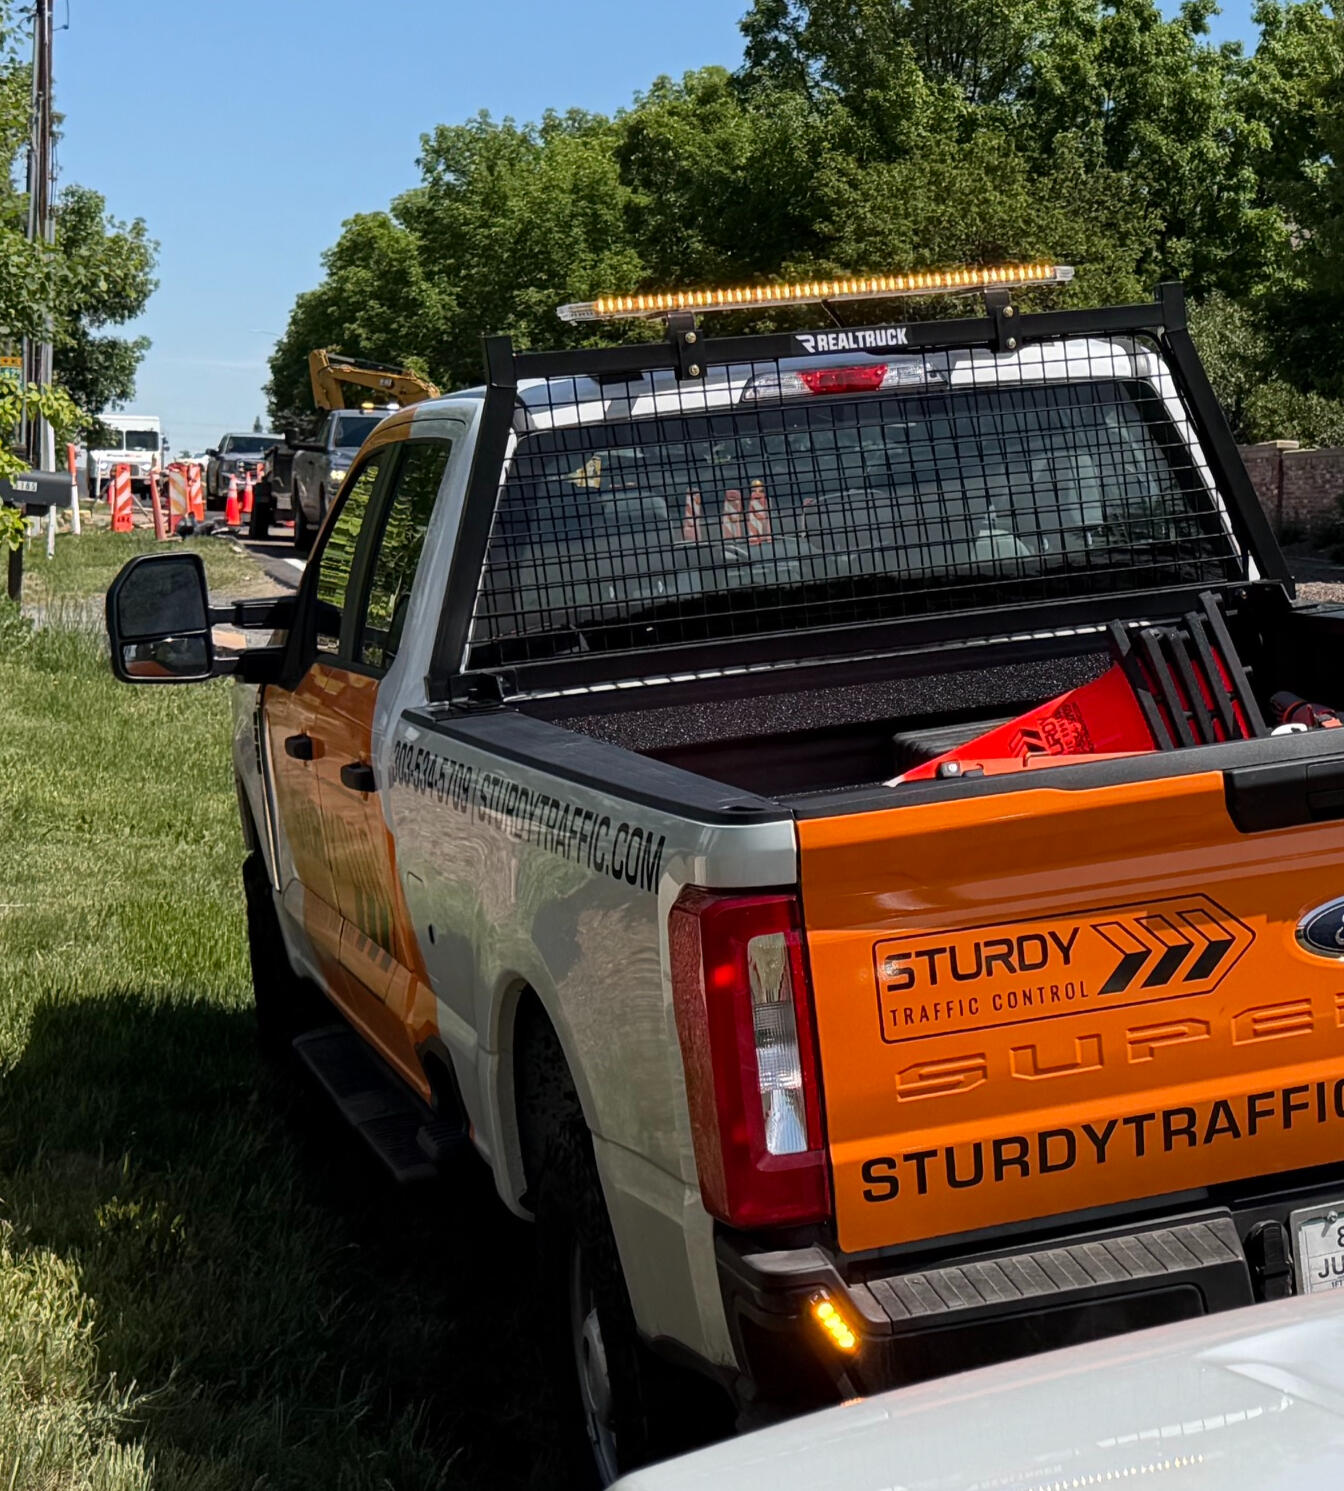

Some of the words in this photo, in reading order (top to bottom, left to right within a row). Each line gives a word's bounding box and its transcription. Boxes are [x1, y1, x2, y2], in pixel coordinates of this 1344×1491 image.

[817, 327, 908, 351] REALTRUCK
[393, 740, 473, 814] 303-534-5709
[479, 773, 666, 895] STURDYTRAFFIC.COM
[886, 926, 1080, 993] STURDY
[890, 997, 980, 1027] TRAFFIC
[993, 980, 1089, 1012] CONTROL
